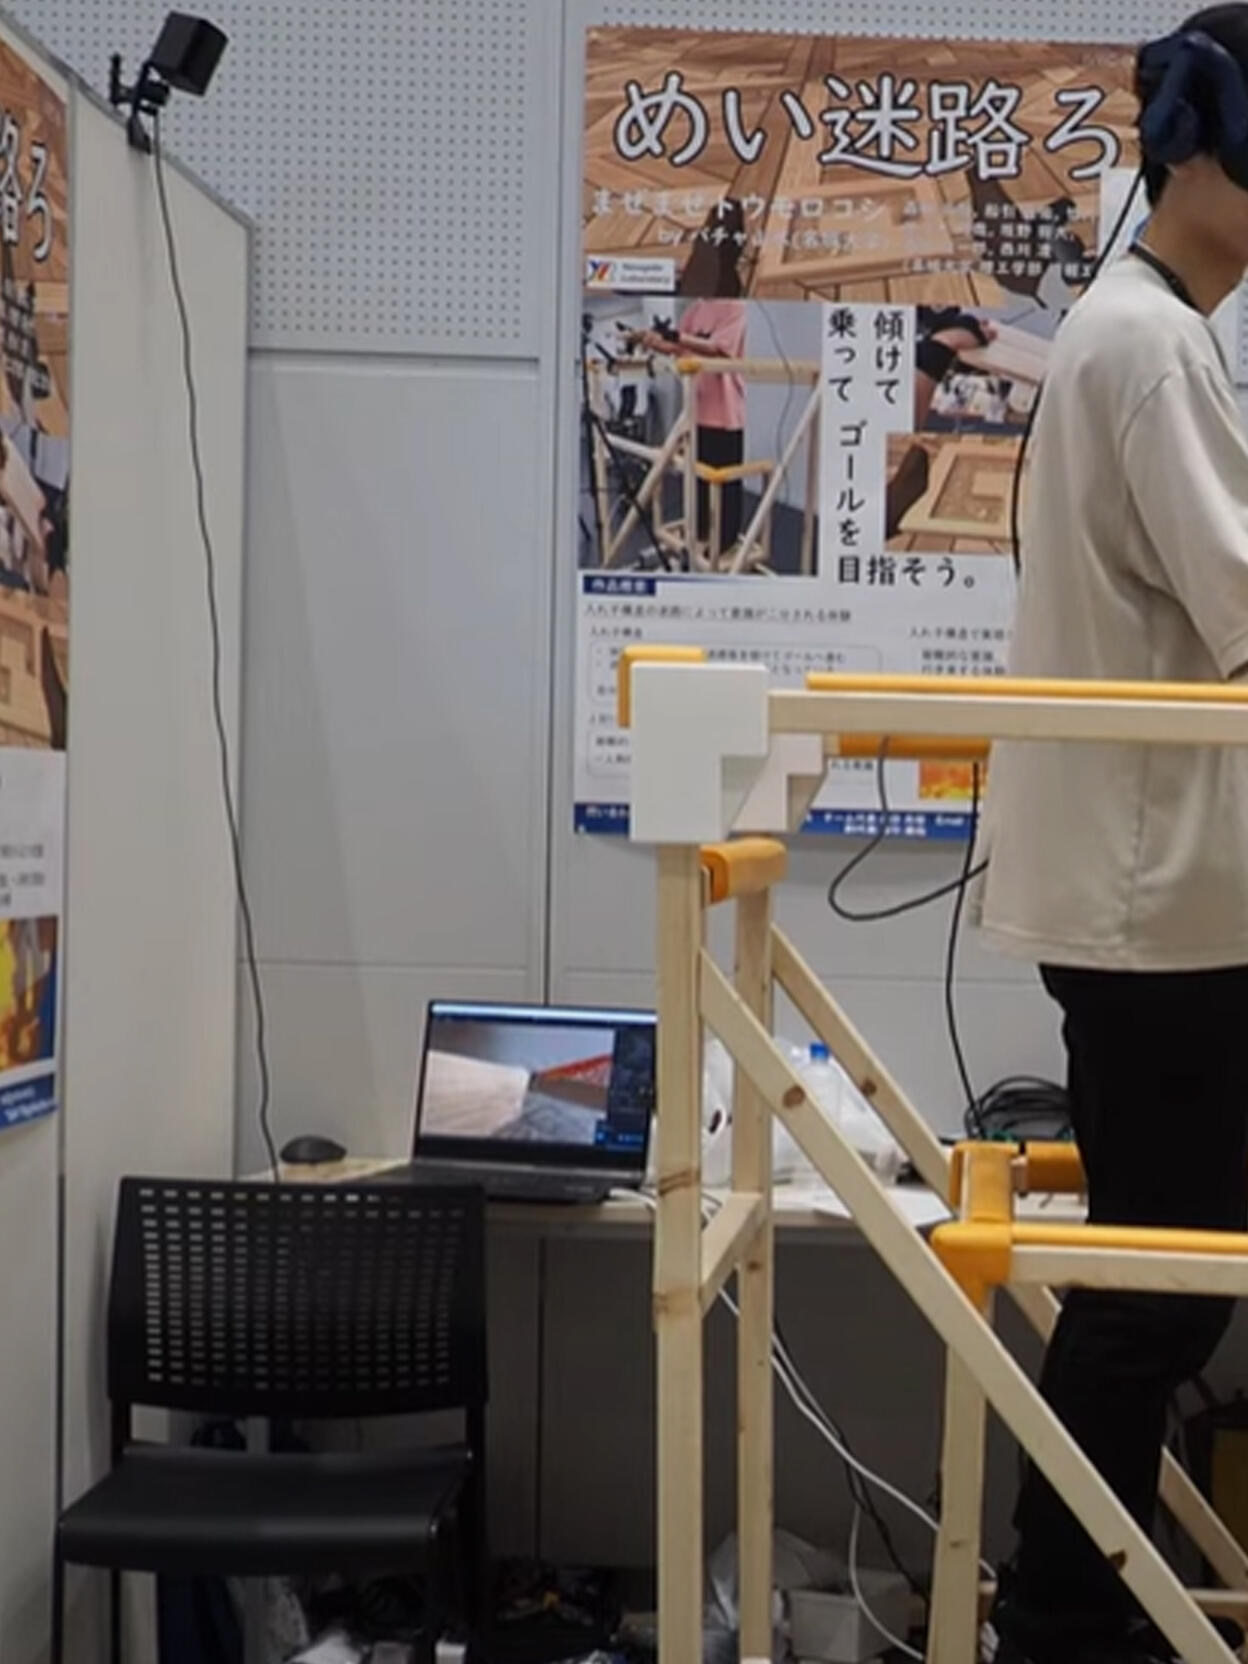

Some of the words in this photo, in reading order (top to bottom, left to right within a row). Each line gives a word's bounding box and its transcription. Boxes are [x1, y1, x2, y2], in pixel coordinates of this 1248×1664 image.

[614, 70, 1122, 180] めい迷路ろ
[827, 310, 858, 402] 乗って
[873, 310, 904, 405] 傾けて
[835, 421, 869, 548] ゴールを
[836, 554, 976, 589] 目指そう。
